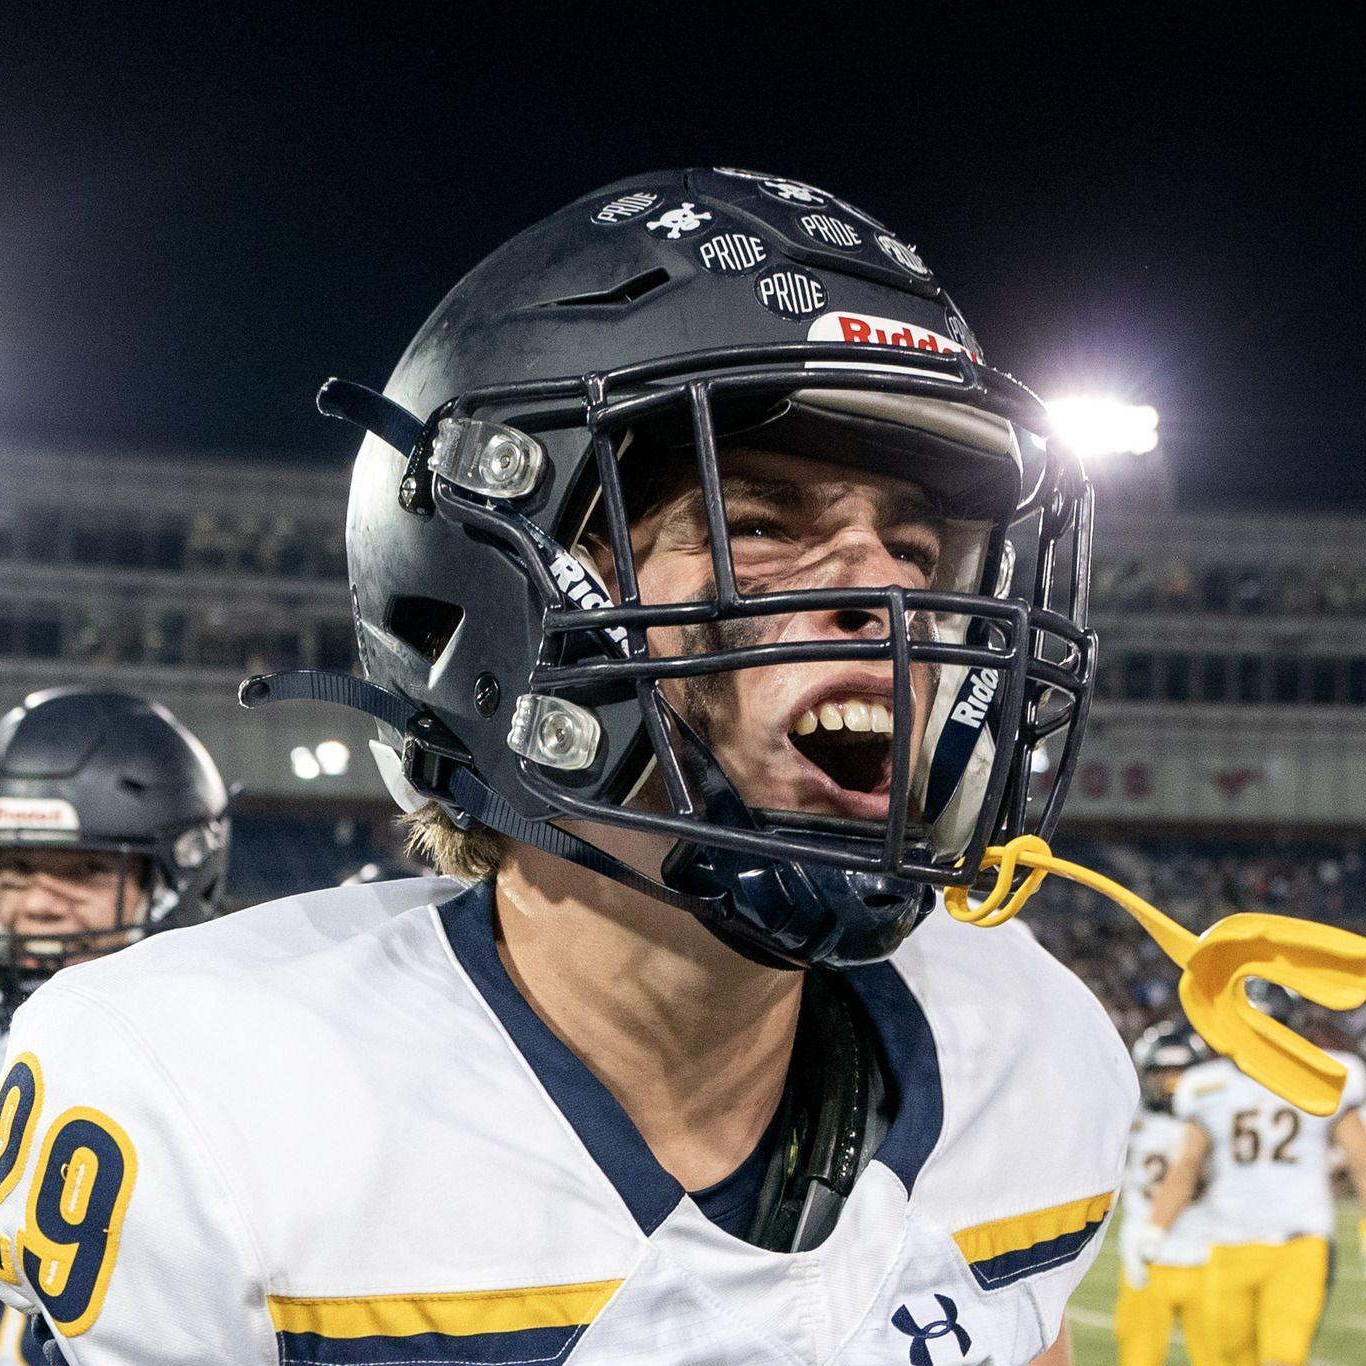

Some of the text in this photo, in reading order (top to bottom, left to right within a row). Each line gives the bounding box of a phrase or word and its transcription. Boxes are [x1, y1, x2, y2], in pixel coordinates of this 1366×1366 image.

[597, 191, 658, 223] PRIDE
[801, 214, 862, 246] PRIDE
[699, 233, 767, 271] PRIDE
[759, 271, 825, 314] PRIDE
[1232, 1107, 1302, 1167] 52
